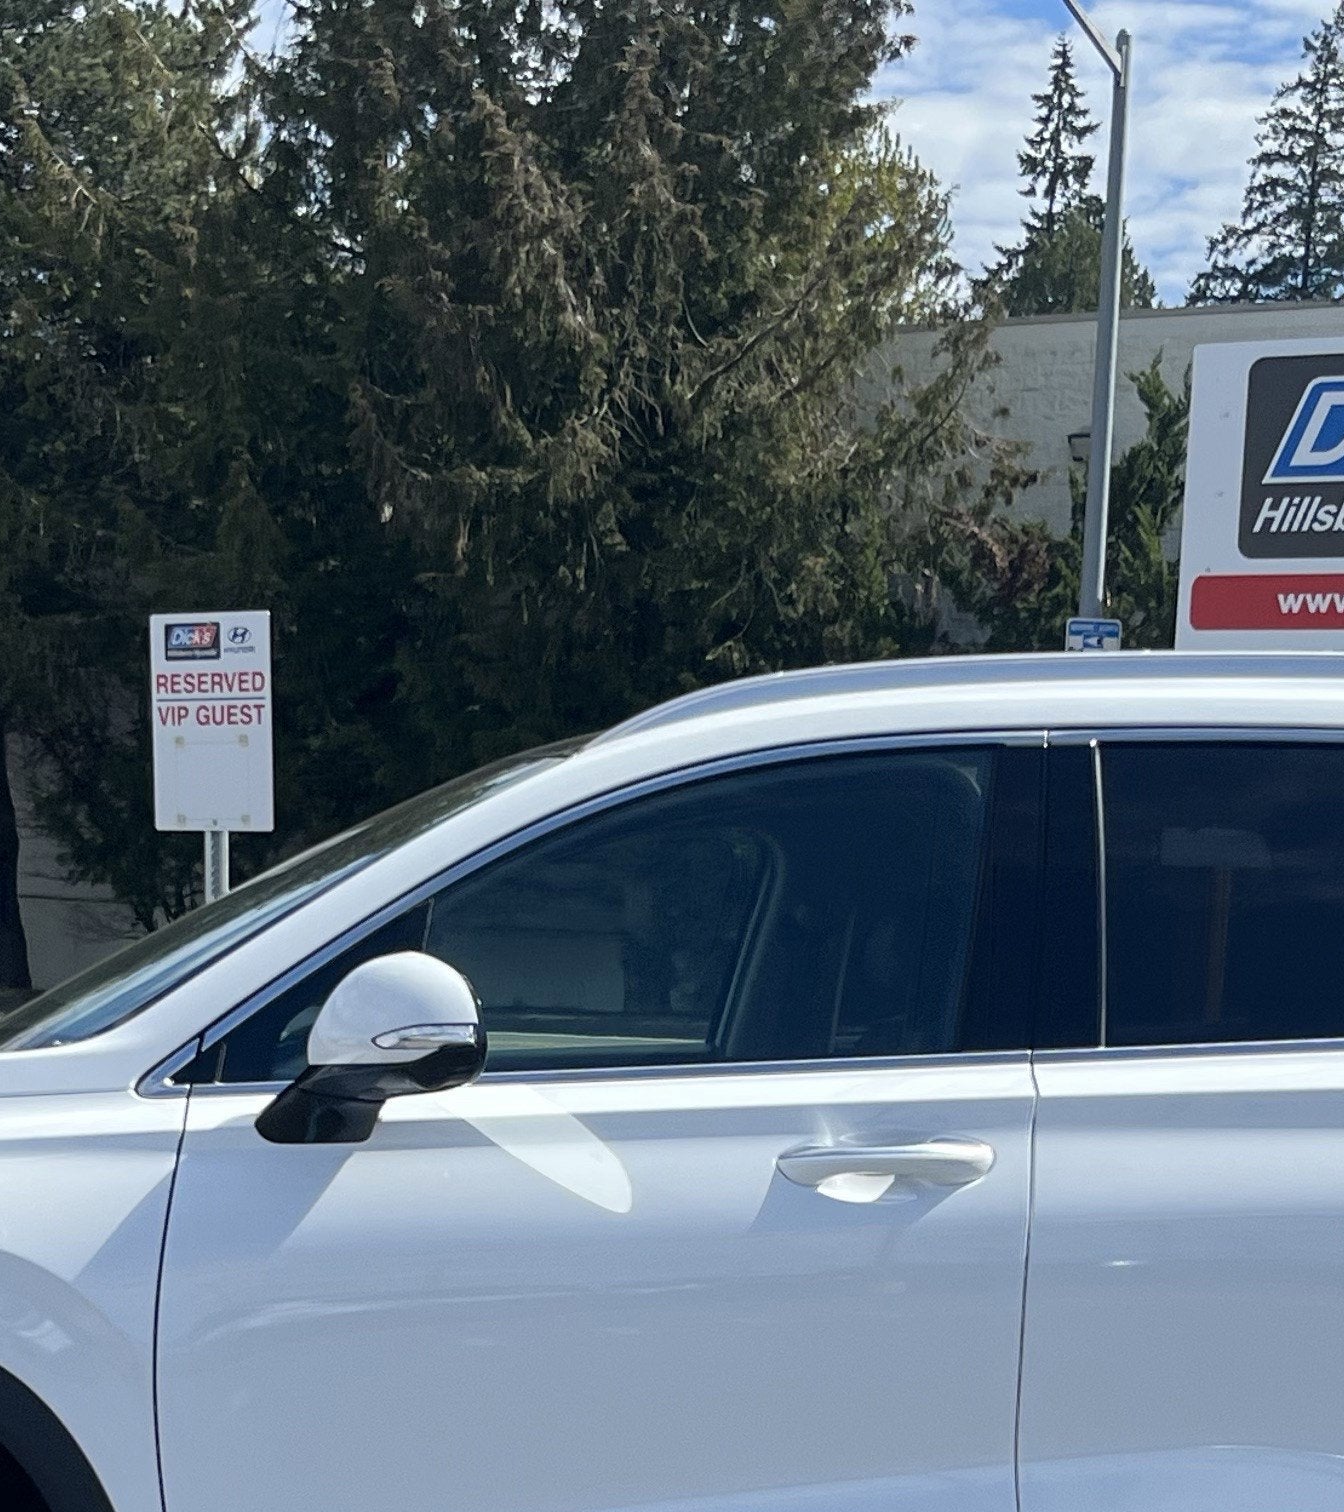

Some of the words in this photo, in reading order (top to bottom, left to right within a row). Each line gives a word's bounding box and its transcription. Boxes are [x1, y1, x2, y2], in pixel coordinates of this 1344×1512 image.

[156, 671, 266, 695] RESERVED
[157, 705, 189, 727] VIP
[195, 704, 266, 726] GUEST
